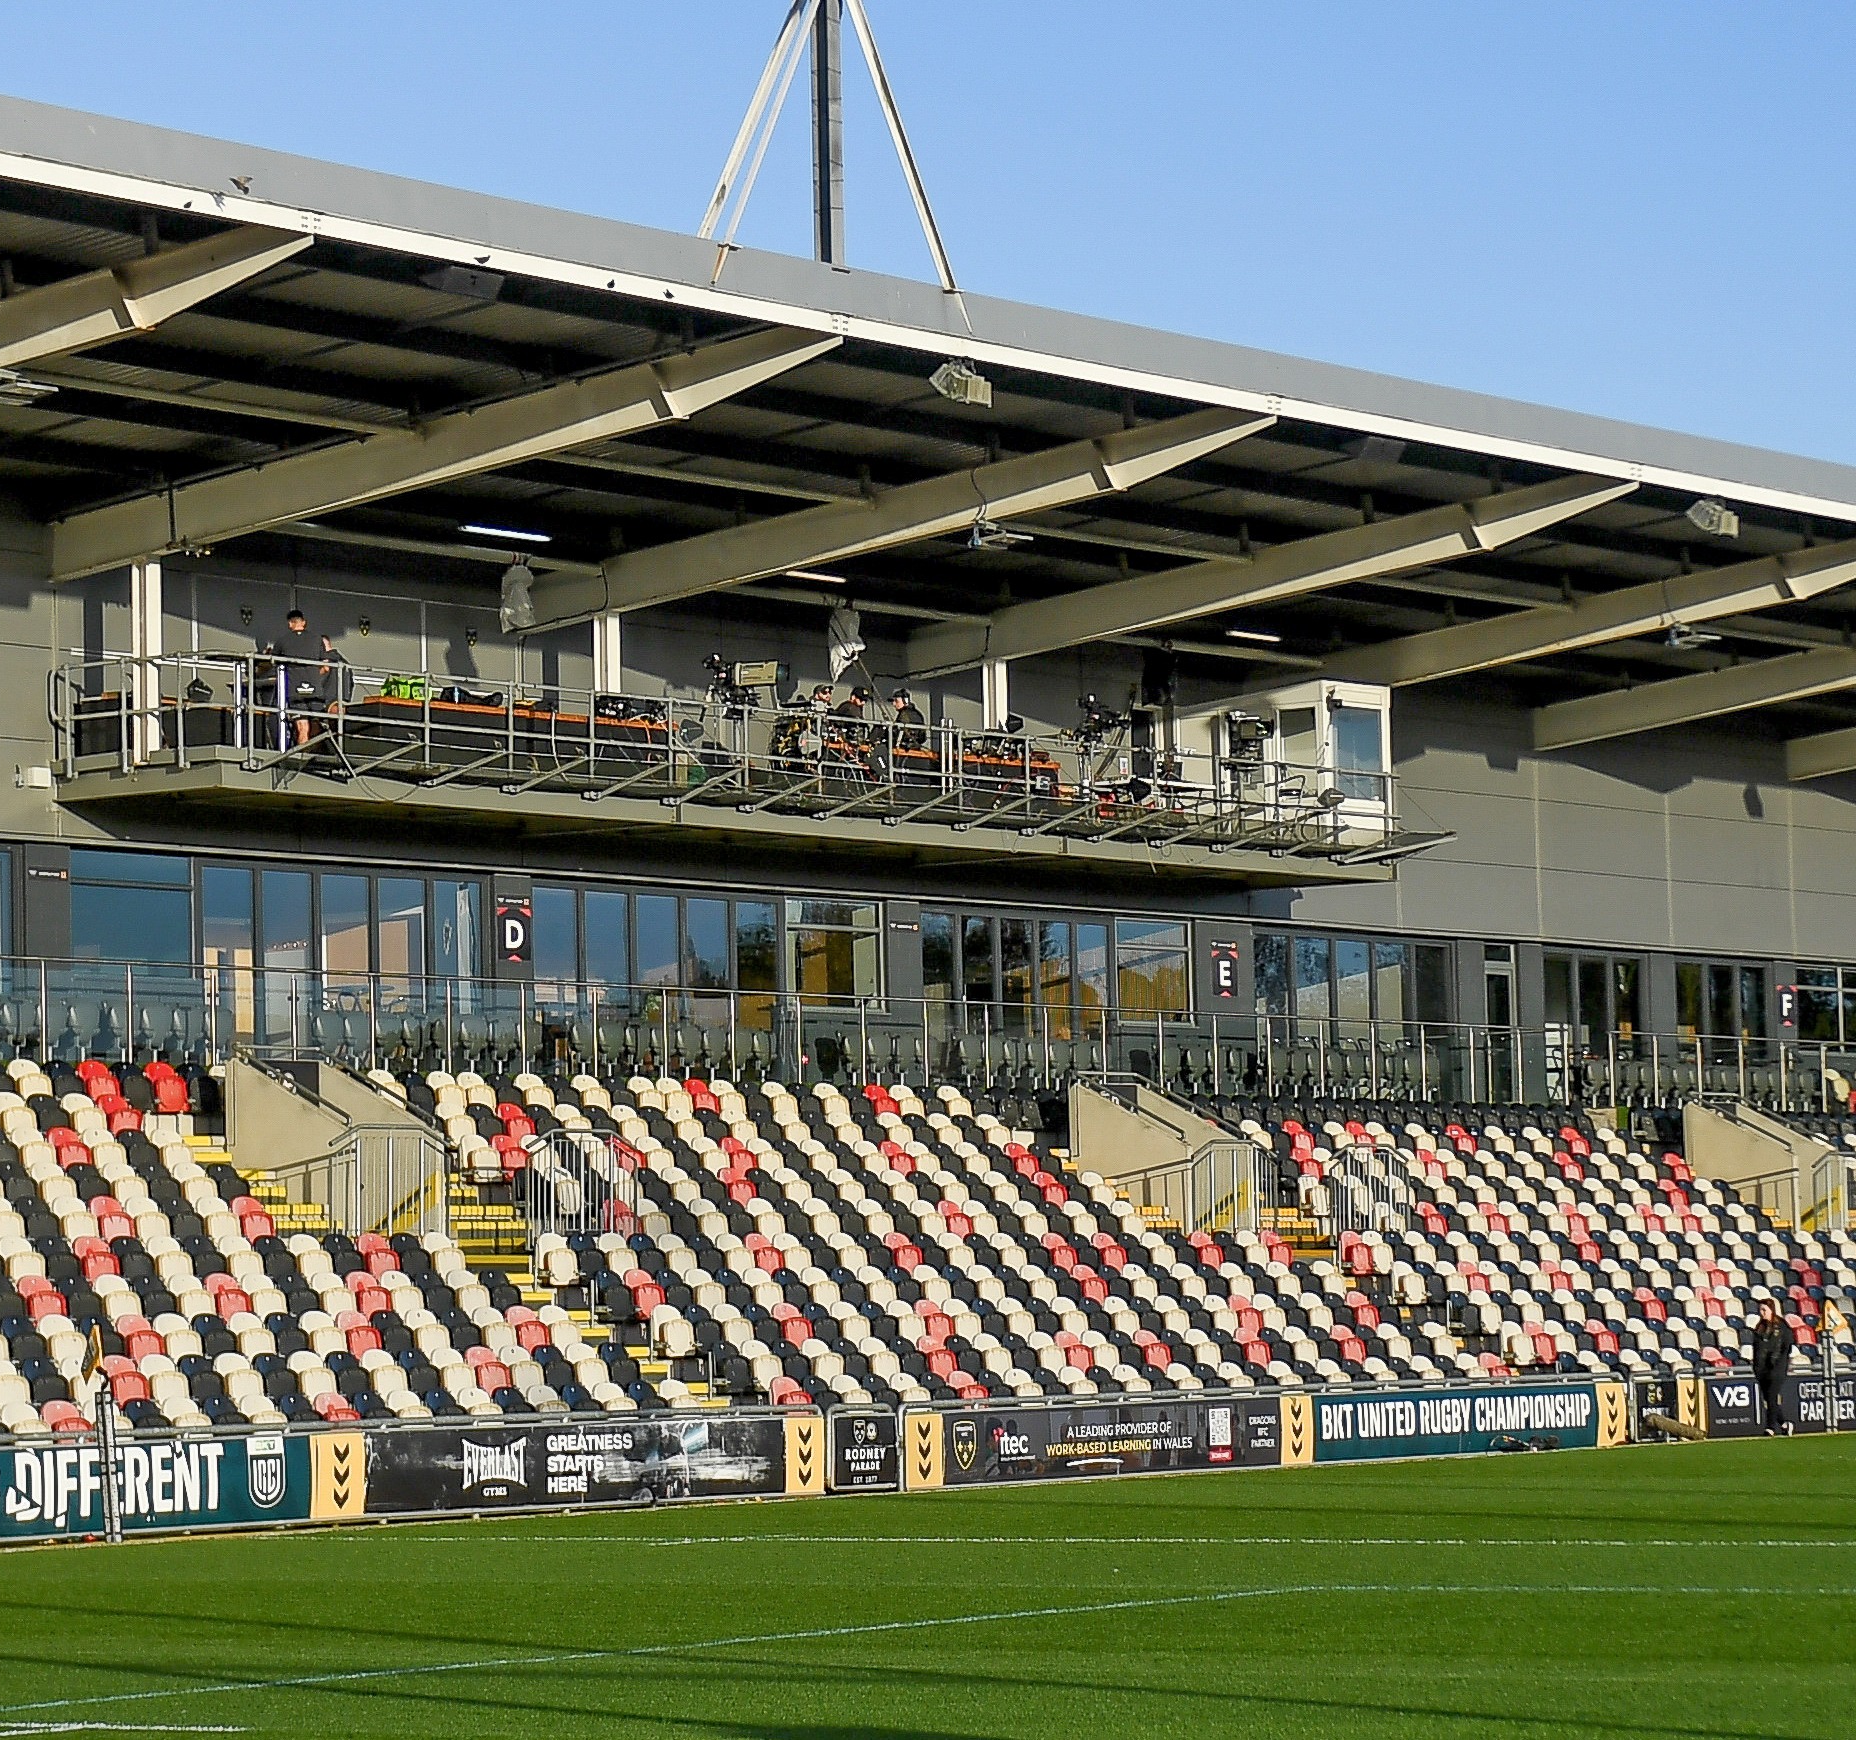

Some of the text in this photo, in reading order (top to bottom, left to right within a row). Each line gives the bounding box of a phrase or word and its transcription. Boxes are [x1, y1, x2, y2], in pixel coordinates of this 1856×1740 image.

[505, 919, 524, 949] D
[1219, 960, 1232, 987] E
[1782, 993, 1793, 1017] F
[1321, 1394, 1591, 1440] BKT UNITED RUGBY CHAMPIONSHIP
[1075, 1424, 1114, 1438] LEADING
[1115, 1422, 1158, 1436] PROVIDER
[1159, 1421, 1172, 1433] OF
[546, 1433, 633, 1451] GREATNESS
[1045, 1437, 1193, 1456] WORK-BASED LEARNING IN WALES
[845, 1447, 886, 1460] RODNEY
[461, 1436, 528, 1490] EVERLAST
[547, 1455, 604, 1473] STARTS
[850, 1462, 881, 1472] PARADE
[547, 1476, 588, 1493] HERE
